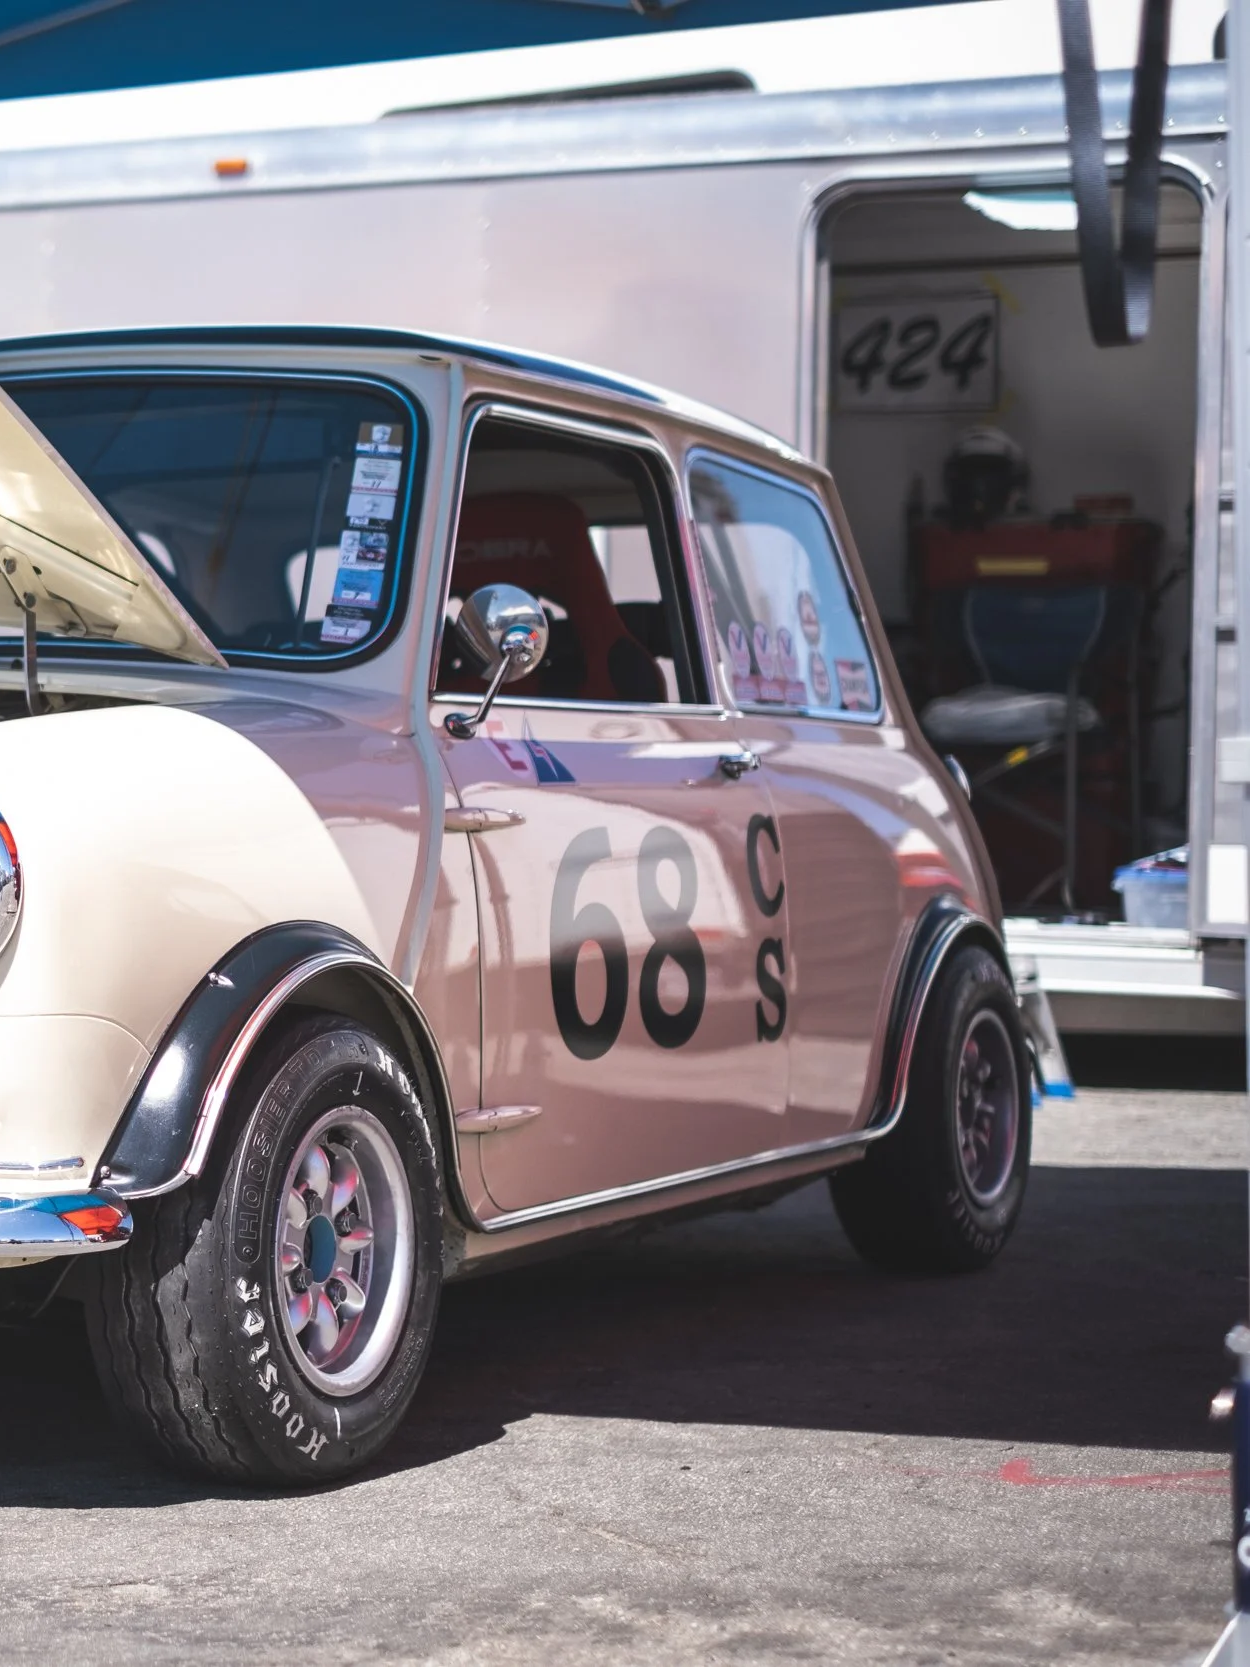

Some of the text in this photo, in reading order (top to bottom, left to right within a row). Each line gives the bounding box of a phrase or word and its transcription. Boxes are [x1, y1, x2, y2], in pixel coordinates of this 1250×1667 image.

[841, 312, 993, 395] 424
[550, 825, 707, 1061] 68
[238, 1077, 298, 1240] HOOSIER
[236, 1276, 330, 1462] HOOSIER
